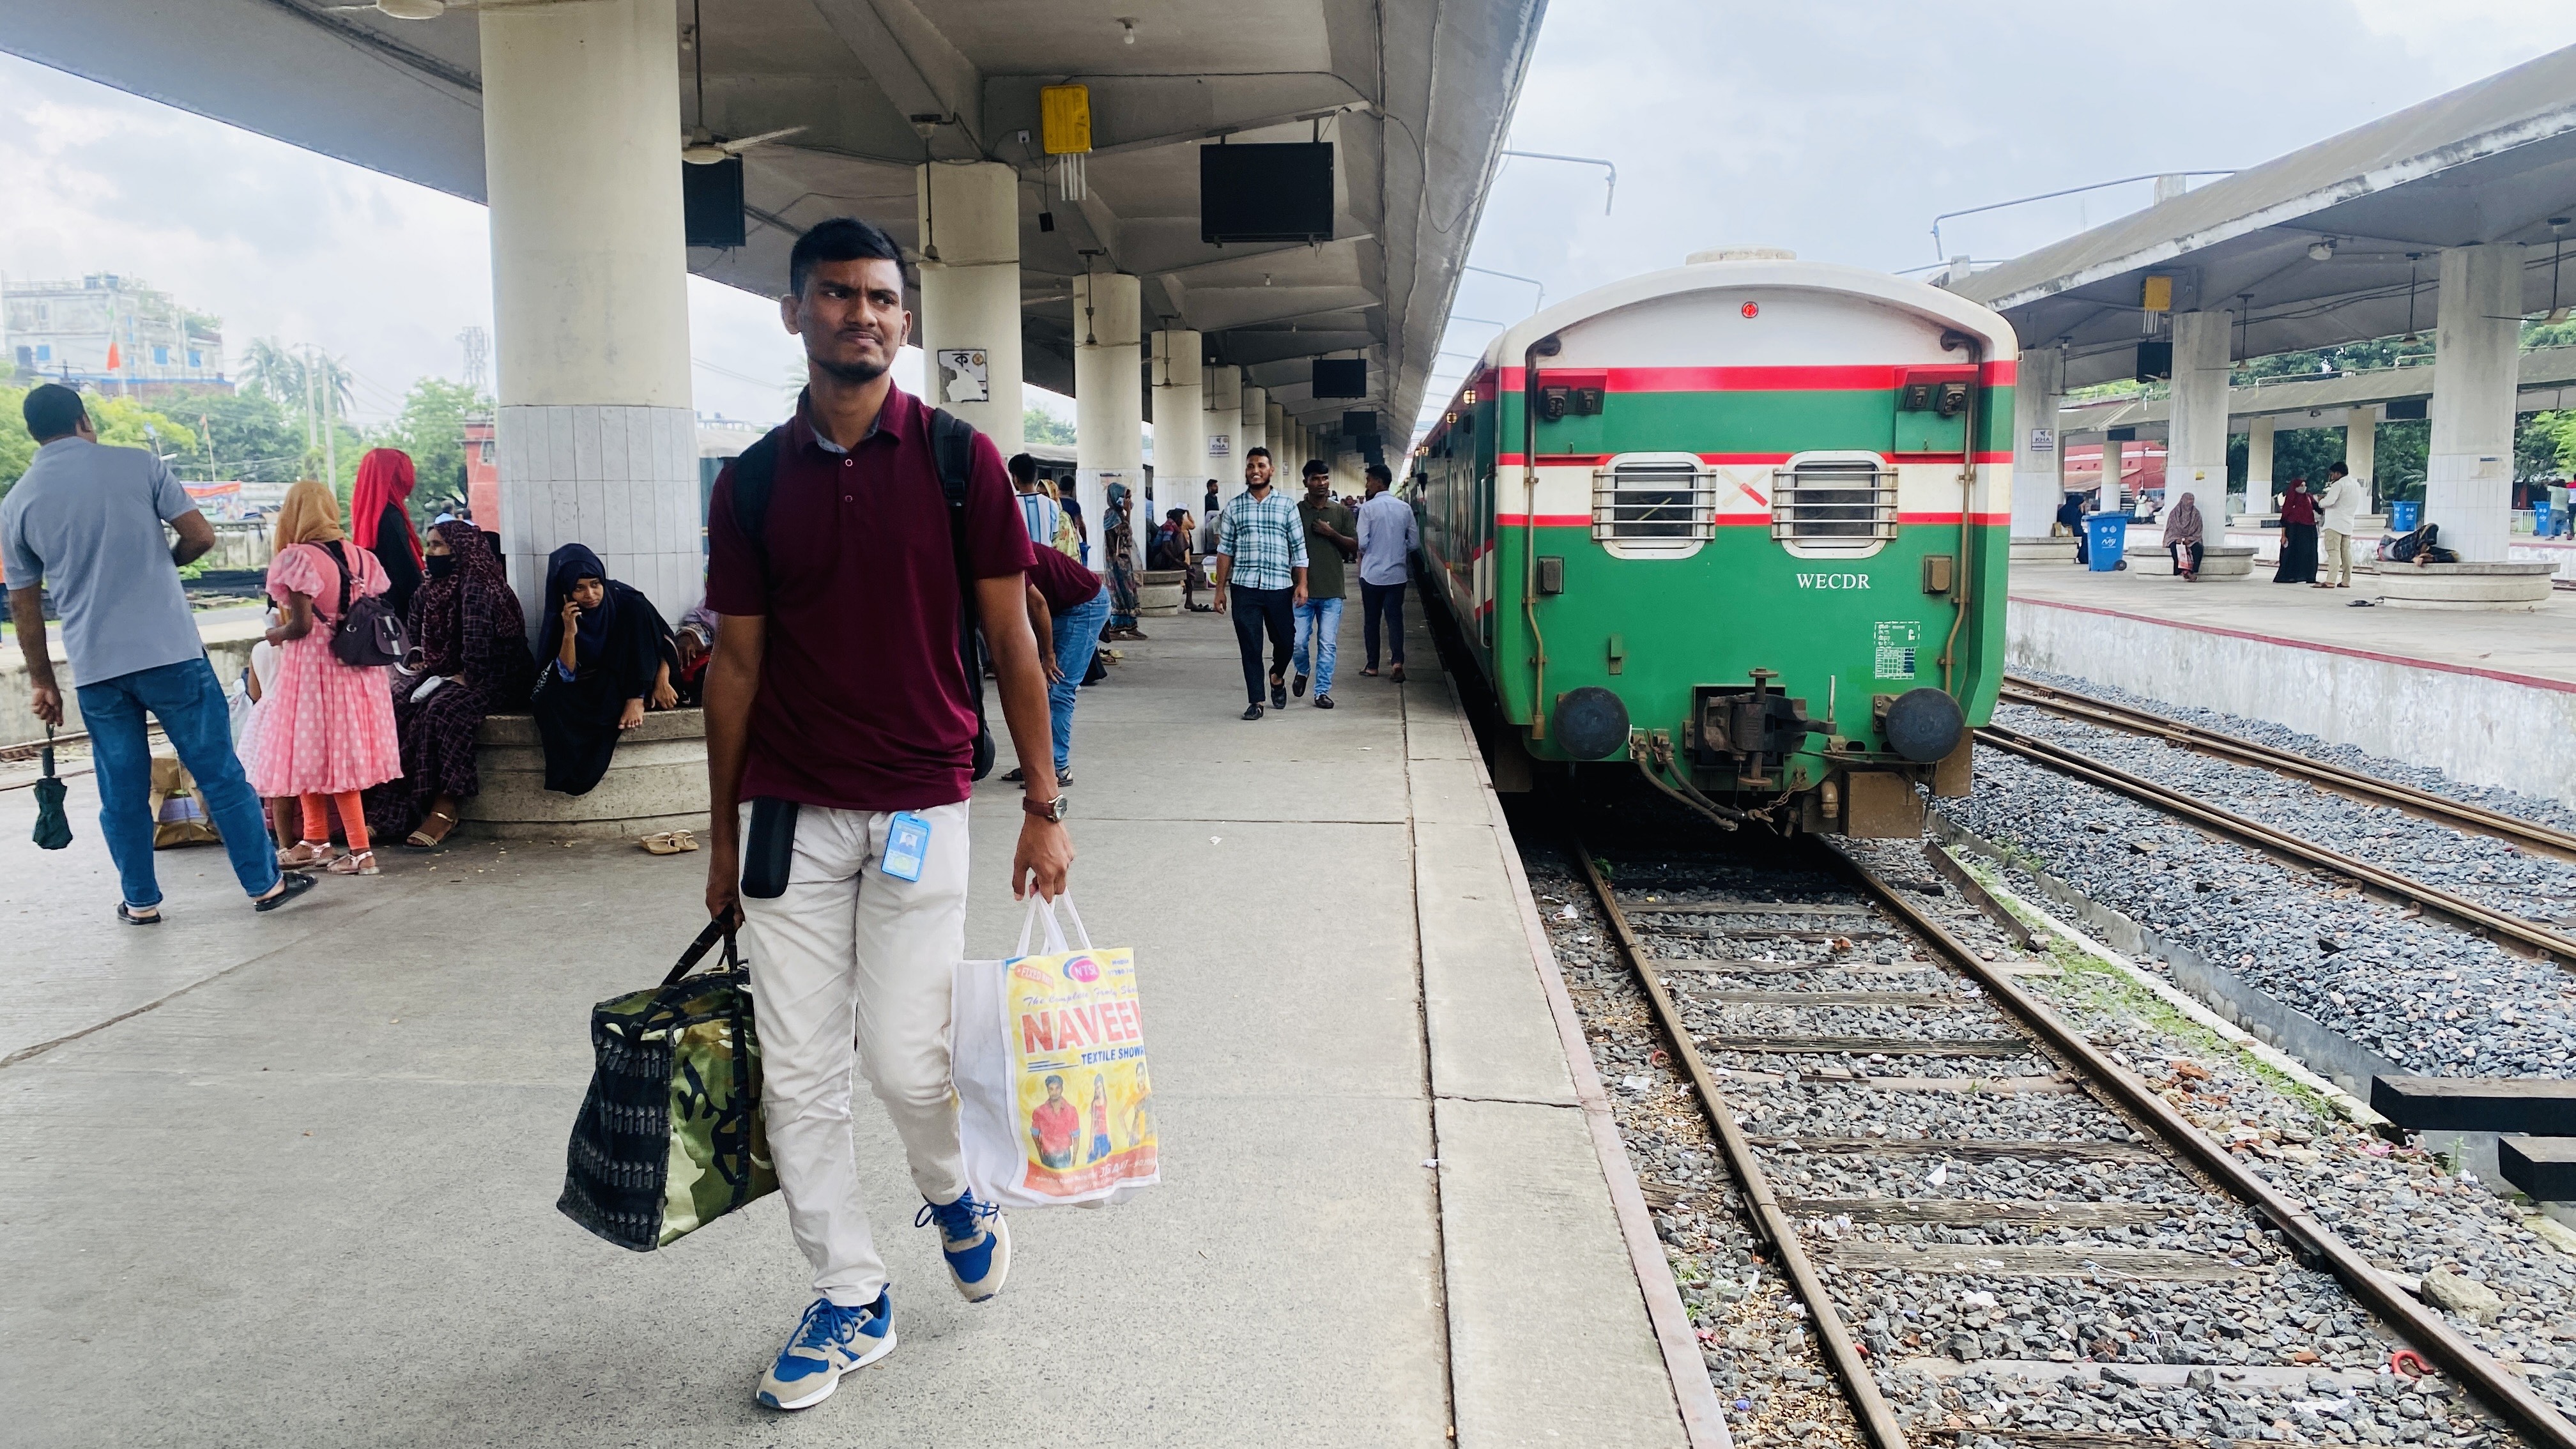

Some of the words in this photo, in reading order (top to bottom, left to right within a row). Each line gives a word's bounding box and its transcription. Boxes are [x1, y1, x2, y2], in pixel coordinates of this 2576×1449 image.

[951, 353, 970, 367] ক
[1796, 572, 1871, 590] WECDR
[1081, 1049, 1116, 1065] TEXTILE
